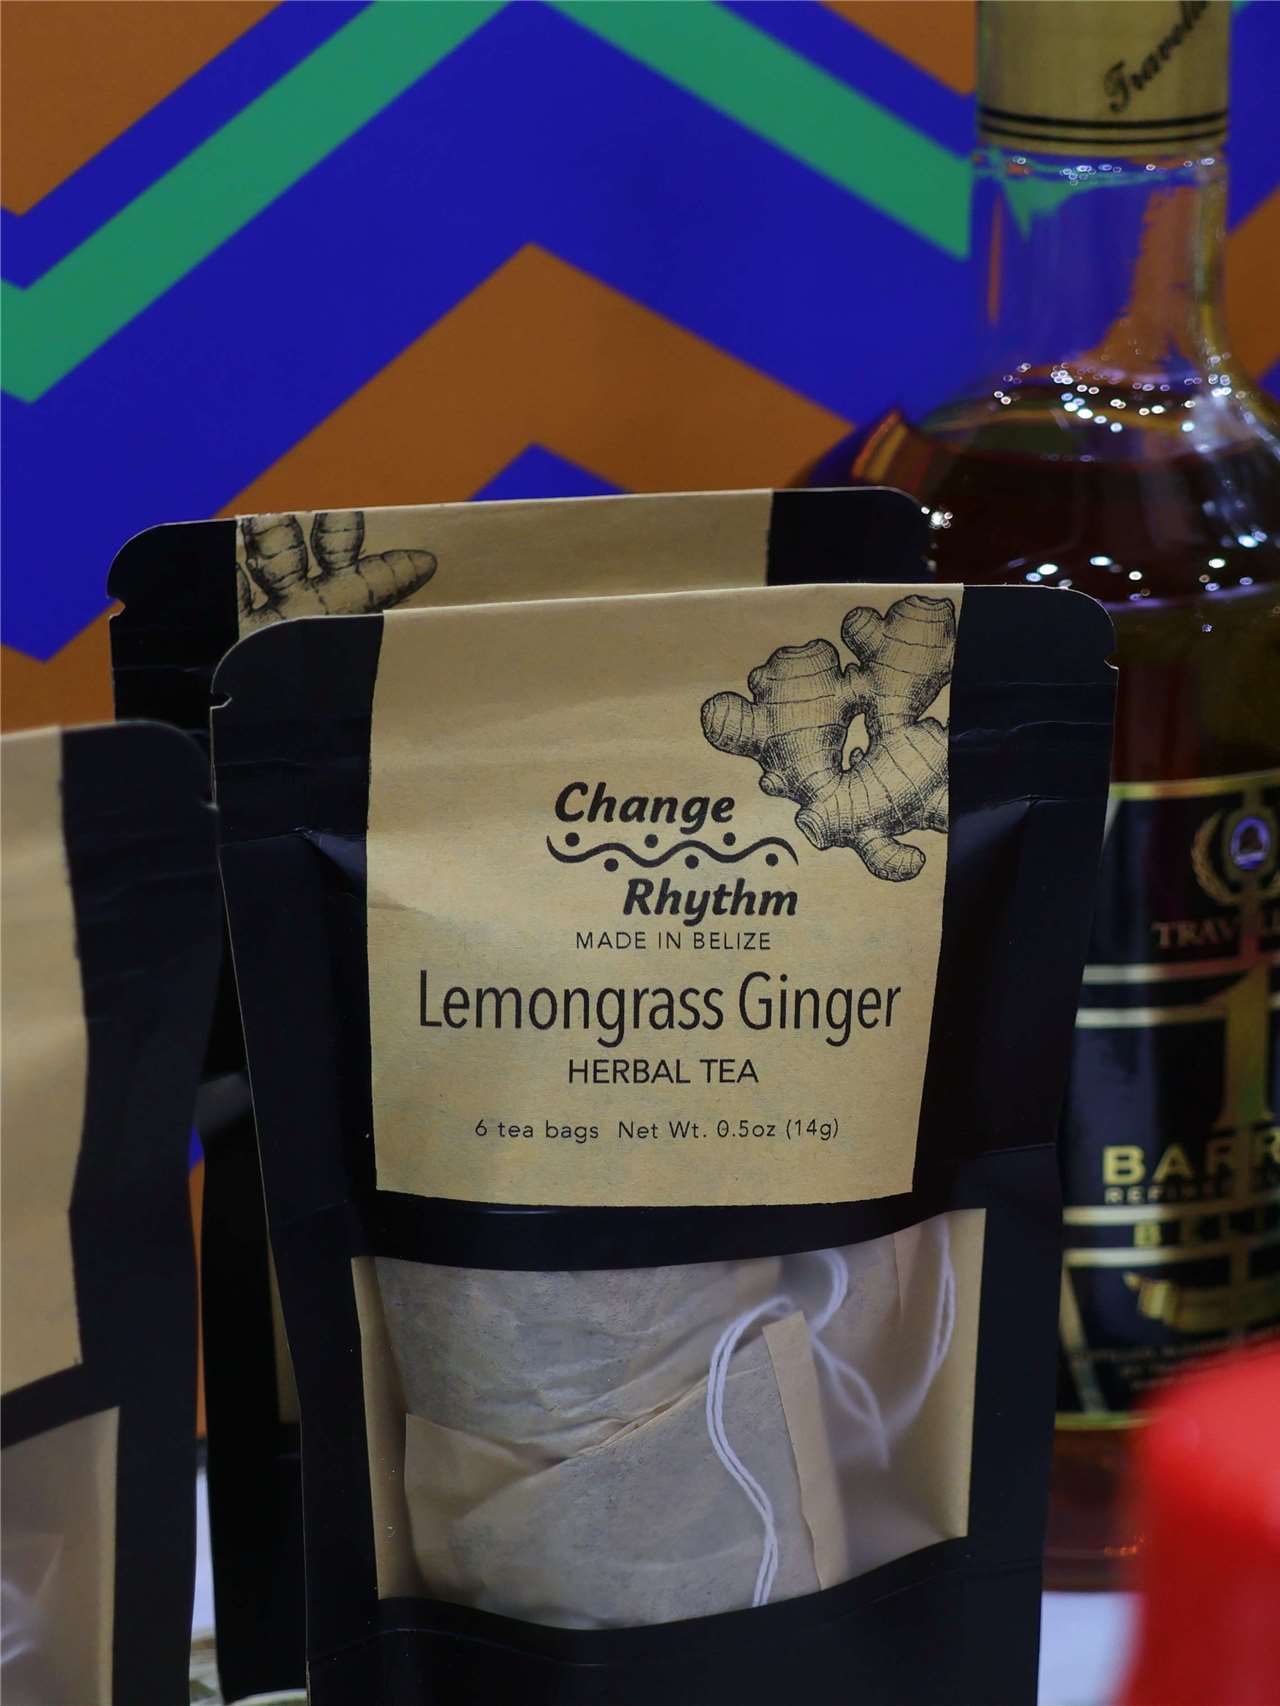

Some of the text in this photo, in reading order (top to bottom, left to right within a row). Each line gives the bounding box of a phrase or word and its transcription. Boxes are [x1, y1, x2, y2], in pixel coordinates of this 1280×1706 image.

[554, 781, 736, 834] Change
[622, 877, 799, 927] Rhythm
[575, 931, 772, 950] MADE IN BELIZE
[419, 969, 902, 1049] Lemongrass Ginger
[567, 1058, 760, 1084] HERBAL TEA
[473, 1118, 840, 1145] 6 tea bags Net Wt. 0.5oz (14g)
